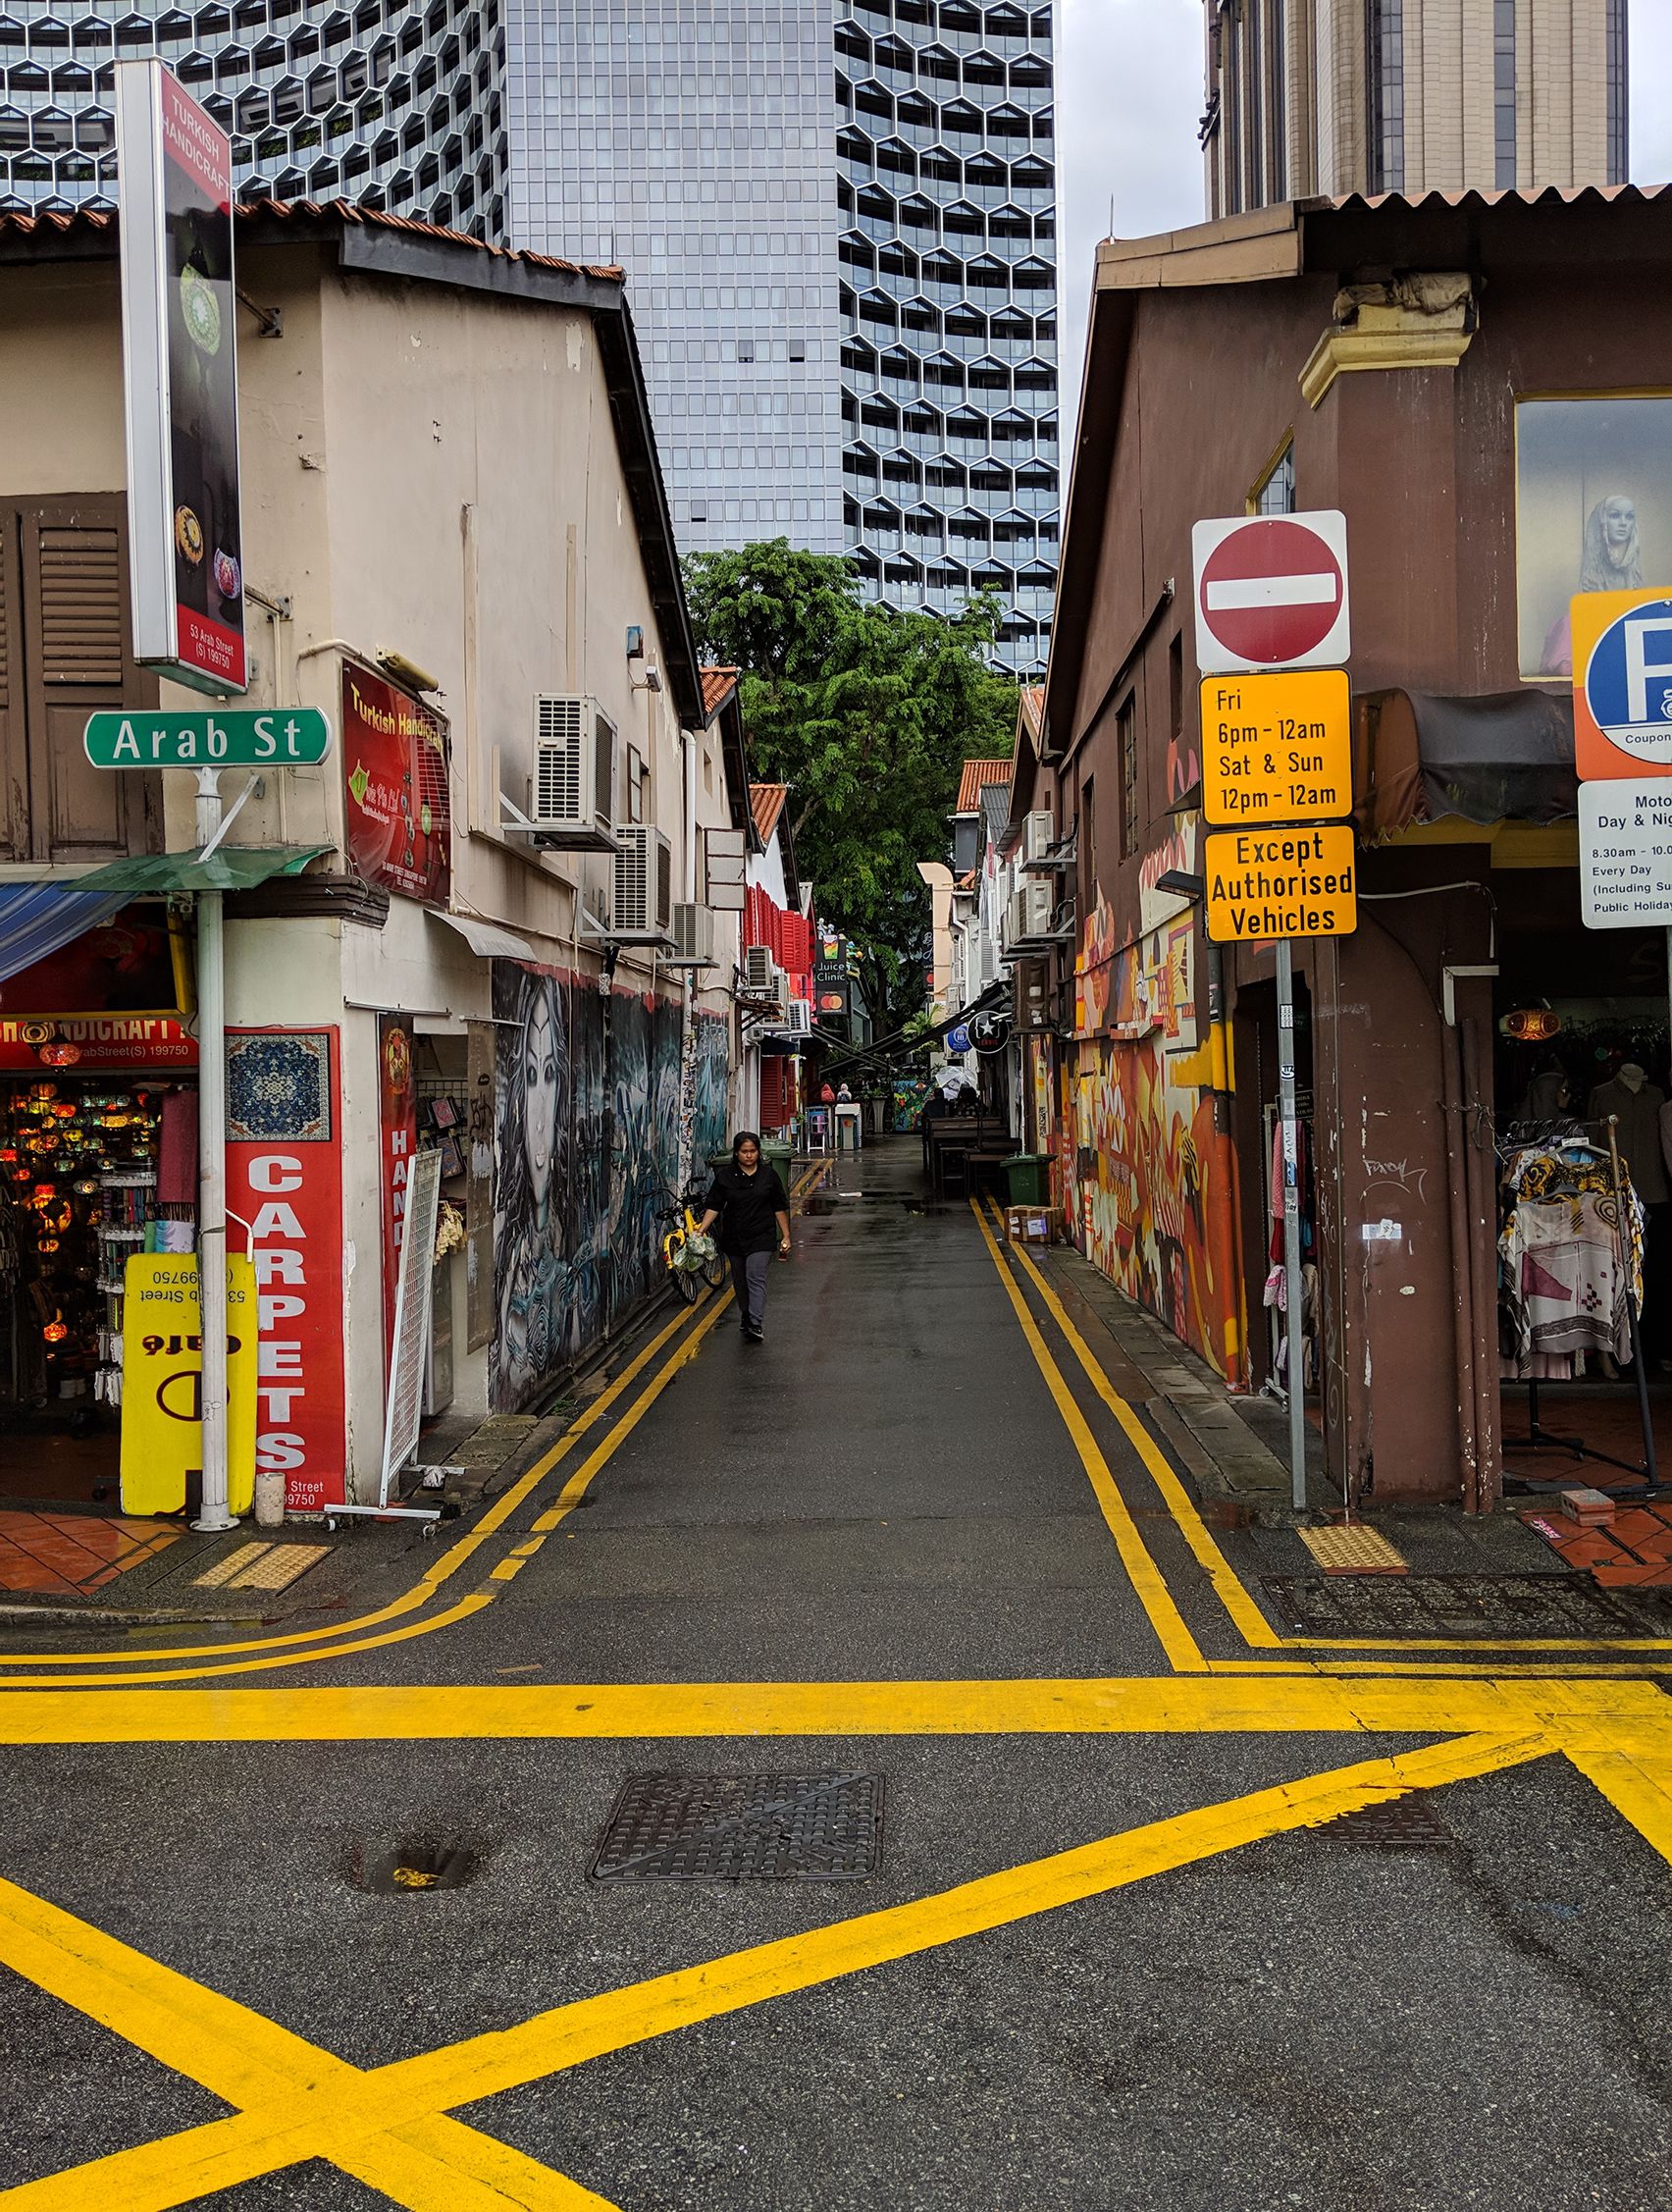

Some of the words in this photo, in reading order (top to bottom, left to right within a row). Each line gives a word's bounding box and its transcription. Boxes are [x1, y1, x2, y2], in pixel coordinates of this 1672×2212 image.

[172, 94, 219, 162] TURKISH
[162, 112, 230, 199] HANDICRAFT
[190, 623, 199, 640] 53
[200, 629, 214, 647] Arab
[216, 637, 234, 657] Street
[196, 643, 205, 660] (S)
[207, 648, 231, 669] 199750
[350, 682, 395, 735] Turkish
[1217, 689, 1241, 711] Fri
[112, 718, 228, 759] Arab
[253, 716, 301, 757] St
[1218, 722, 1258, 749] 6pm
[1278, 718, 1326, 740] 12am
[1625, 733, 1671, 745] Coupon
[1220, 755, 1251, 776] Sat
[1264, 754, 1276, 773] &
[1288, 752, 1324, 772] Sun
[1221, 788, 1269, 814] 12pm
[1288, 784, 1336, 805] 12am
[1597, 816, 1627, 830] Day
[1634, 814, 1645, 826] &
[1236, 832, 1324, 868] Except
[1592, 848, 1637, 859] 8.30am
[1593, 866, 1626, 876] Every
[1630, 865, 1652, 876] Day
[1212, 866, 1353, 902] Authorised
[1593, 882, 1651, 896] (Including
[1594, 902, 1629, 913] Public
[1230, 904, 1335, 935] Vehicles
[816, 972, 846, 982] Clinic
[817, 963, 845, 973] Juice
[150, 1045, 188, 1056] 199750
[392, 1130, 408, 1261] HAND
[152, 1271, 198, 1285] 99750
[140, 1290, 184, 1303] Street
[228, 1290, 245, 1303] 53
[248, 1155, 307, 1470] CARPETS
[290, 1480, 324, 1493] Street
[283, 1493, 315, 1505] 9750
